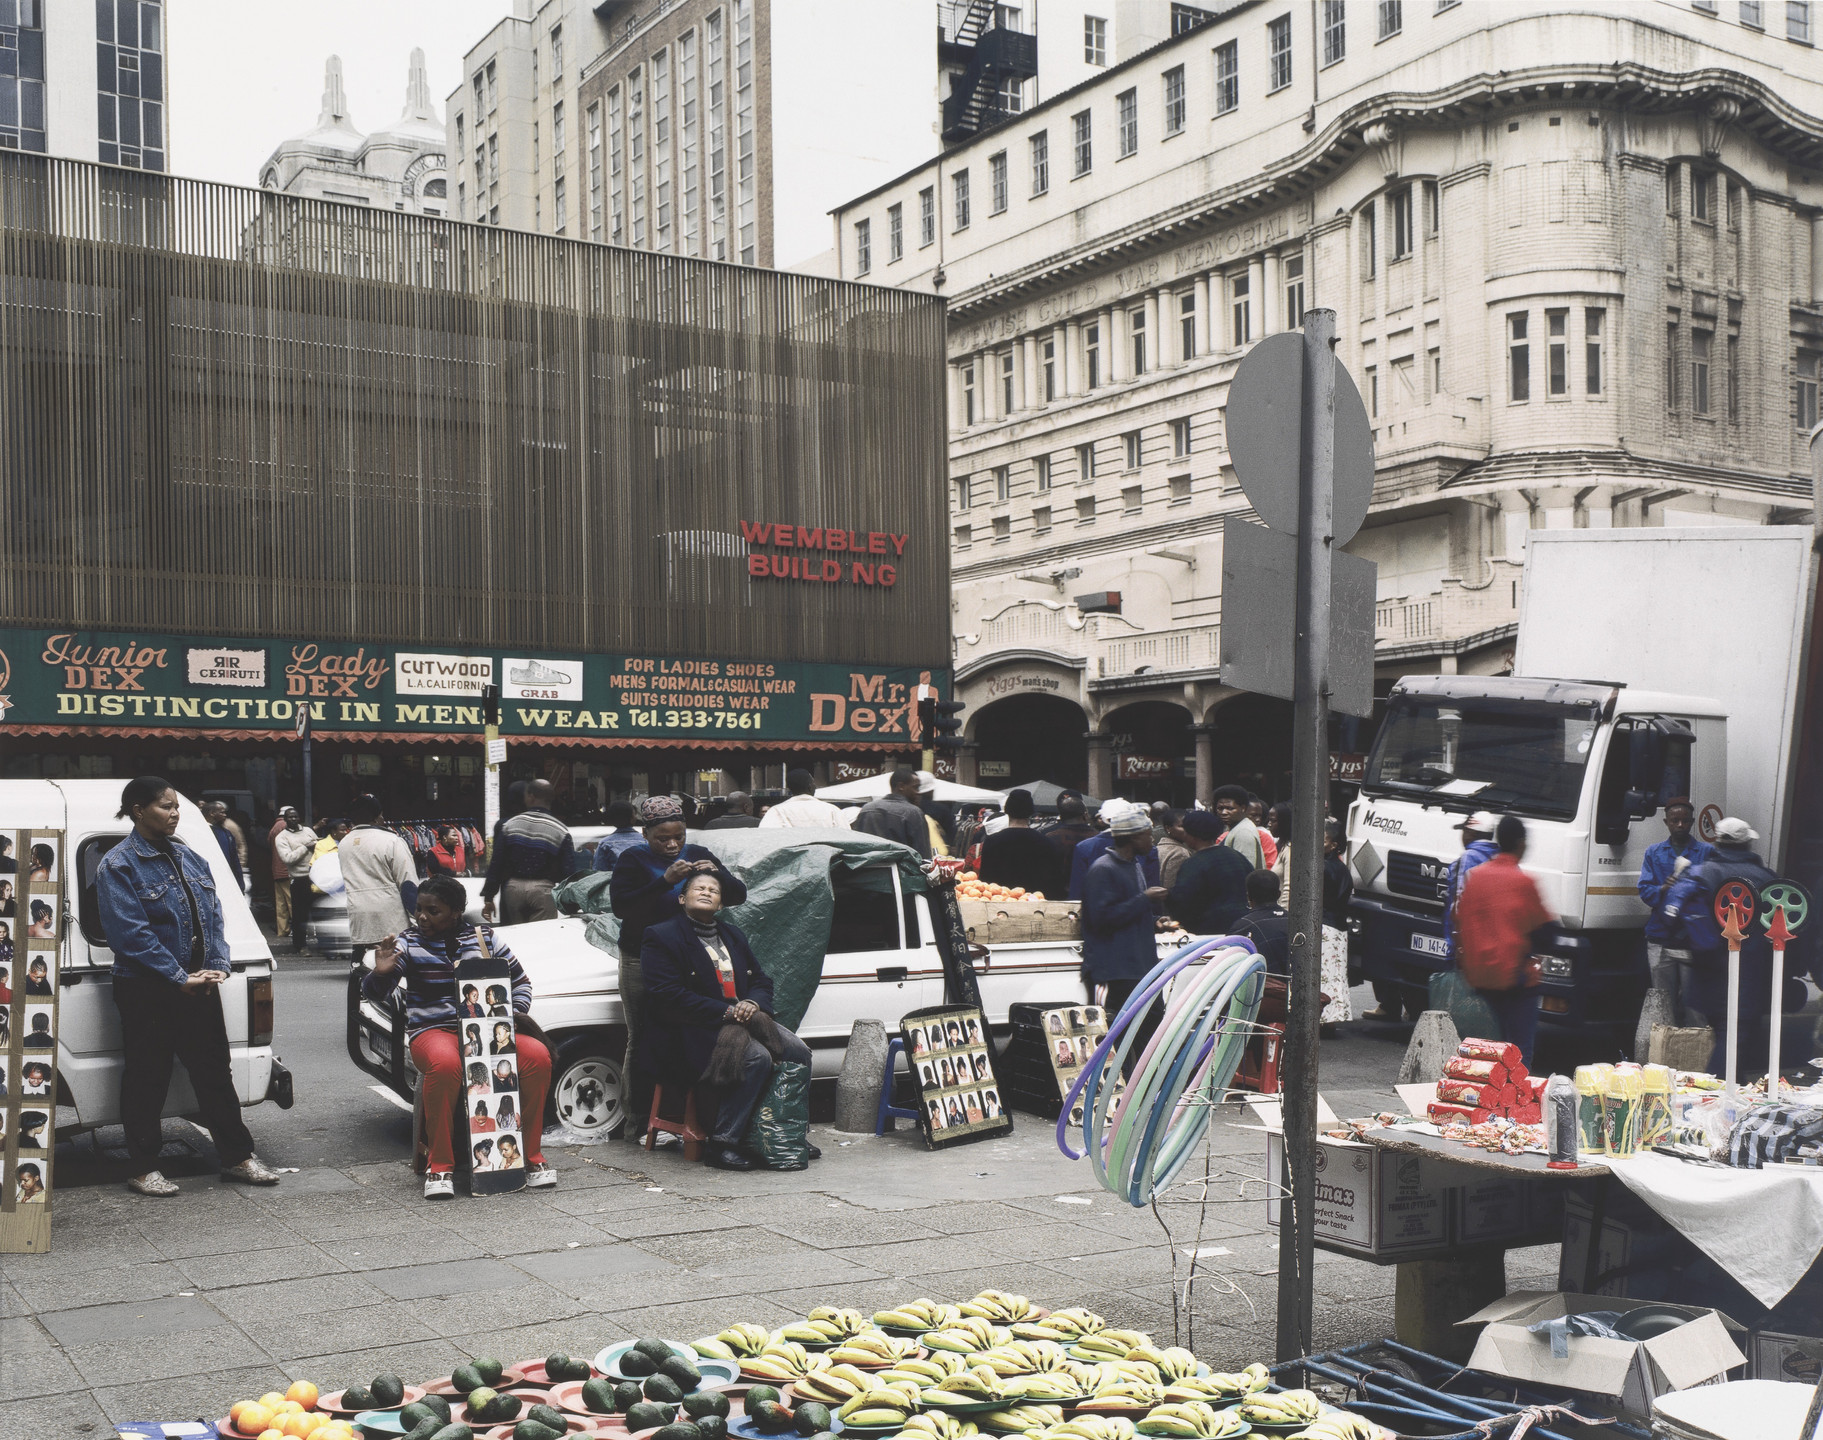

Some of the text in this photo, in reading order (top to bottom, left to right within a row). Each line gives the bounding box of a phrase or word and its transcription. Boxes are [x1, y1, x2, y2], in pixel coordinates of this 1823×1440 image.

[1038, 284, 1097, 322] GUILD
[1115, 262, 1160, 294] WAR
[1174, 215, 1288, 274] MEMORIAL
[740, 520, 909, 555] WEMBLEY
[42, 632, 169, 668] Junior
[199, 669, 260, 680] CERRUTI
[285, 643, 391, 690] Lady
[400, 660, 490, 677] CUTWOOD
[624, 658, 775, 677] FOR LADIES SHOES
[64, 665, 145, 691] DEX
[286, 673, 359, 697] DEX
[610, 675, 647, 689] MENS
[763, 680, 796, 694] WEAR
[848, 673, 905, 703] Mr.
[986, 675, 1022, 696] Riggs
[1042, 677, 1059, 690] shop
[520, 689, 559, 699] GRAB
[729, 696, 770, 710] WEAR
[56, 693, 326, 721] DISTINCTION
[339, 701, 381, 722] IN
[516, 708, 620, 729] WEAR
[809, 693, 904, 733] Dex
[837, 762, 877, 777] Riggs
[1126, 756, 1169, 773] Riggs
[1363, 810, 1403, 830] M2000
[1314, 1207, 1355, 1222] erfect Snack
[1330, 1220, 1348, 1230] taste
